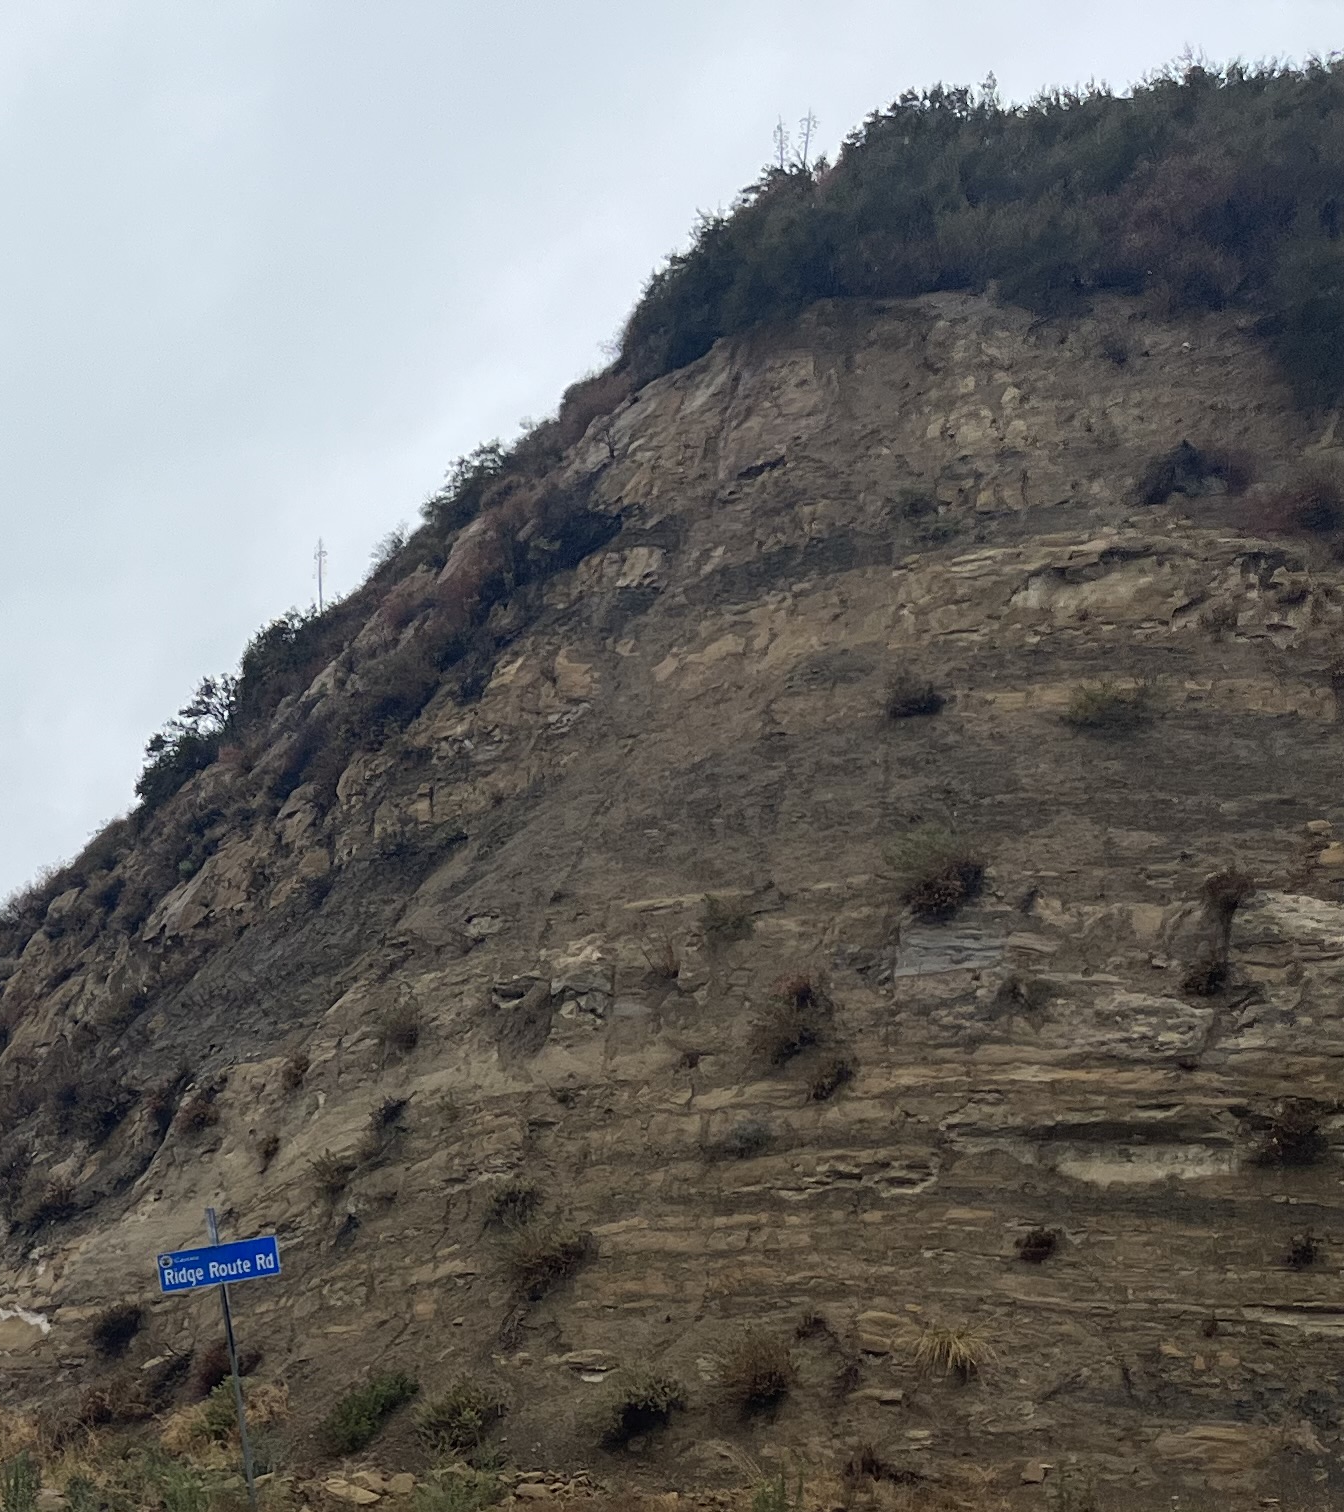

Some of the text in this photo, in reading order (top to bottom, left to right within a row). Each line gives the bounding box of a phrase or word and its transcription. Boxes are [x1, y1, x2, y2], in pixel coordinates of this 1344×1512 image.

[164, 1253, 275, 1286] Ridge Route Rd
